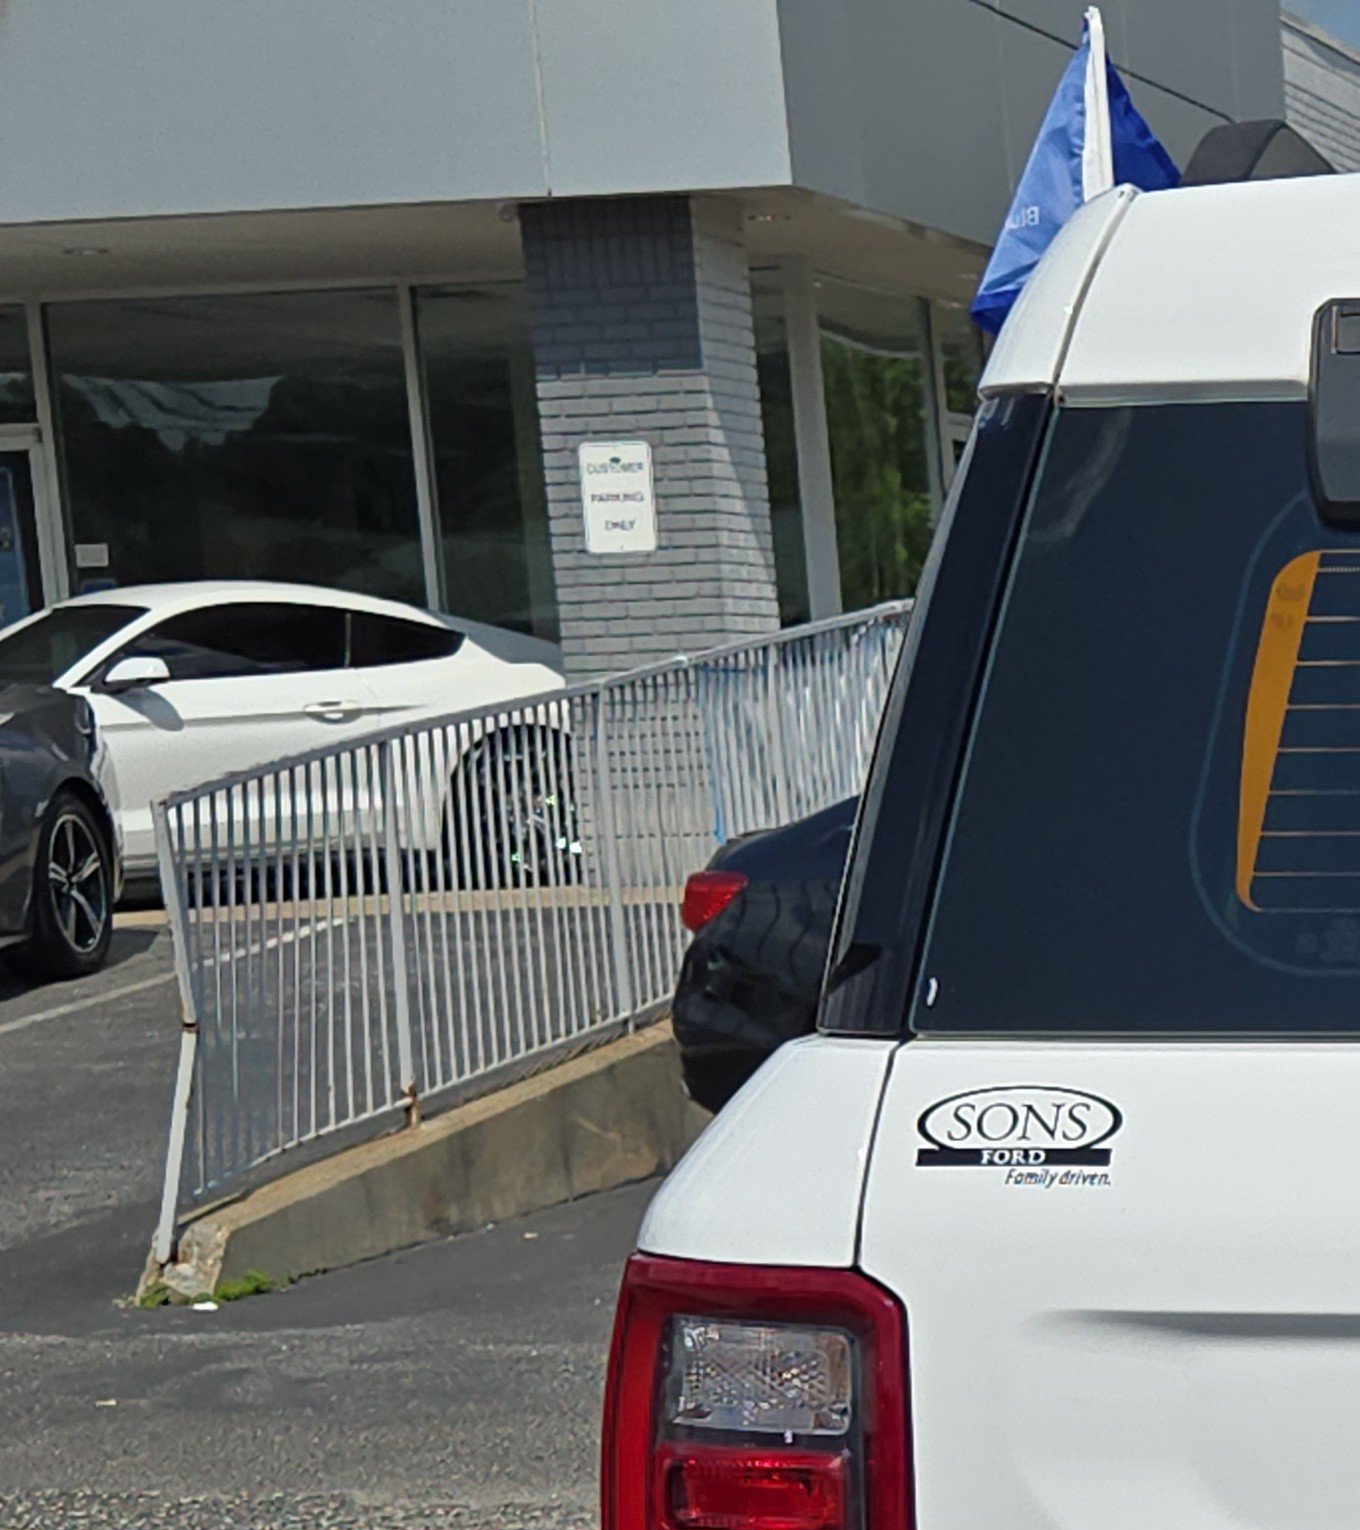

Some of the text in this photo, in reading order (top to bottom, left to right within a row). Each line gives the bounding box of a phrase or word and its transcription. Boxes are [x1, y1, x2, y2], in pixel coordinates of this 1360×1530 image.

[586, 462, 643, 475] CUSTOMER
[590, 491, 645, 503] PARKING
[604, 519, 636, 532] ONLY
[946, 1102, 1092, 1142] SONS
[980, 1149, 1047, 1165] FORD
[1004, 1168, 1112, 1189] Family driven.
